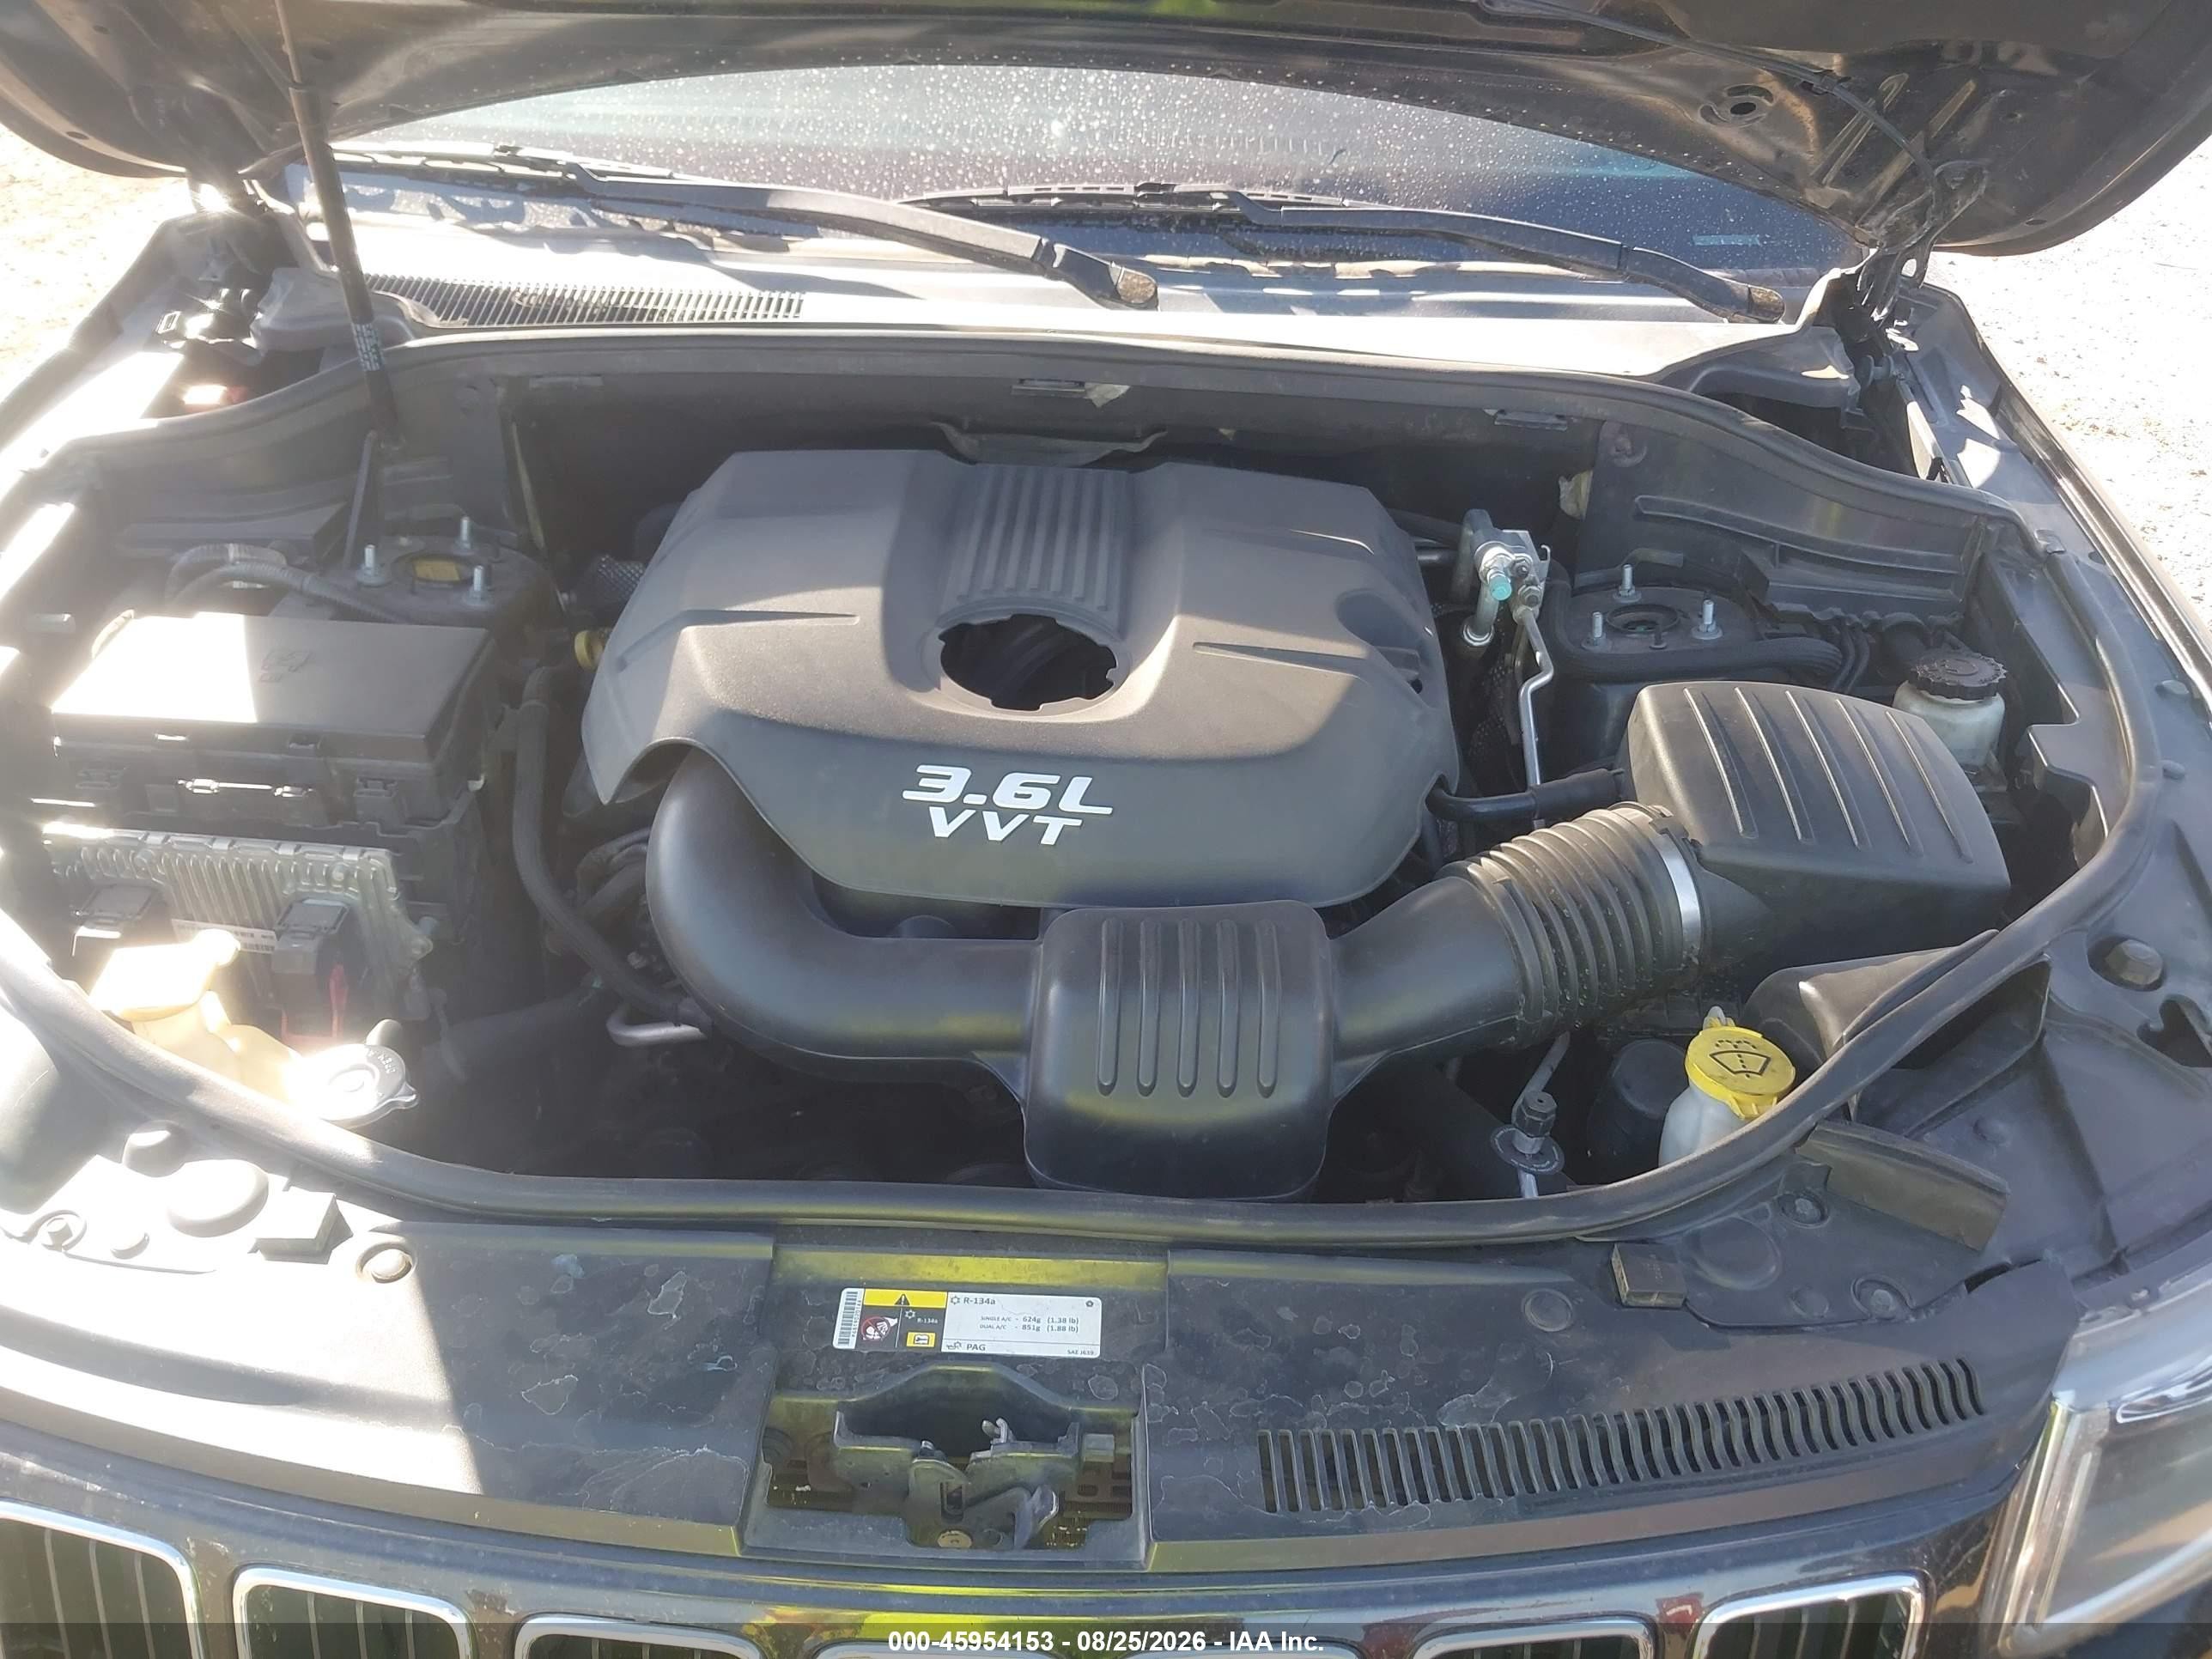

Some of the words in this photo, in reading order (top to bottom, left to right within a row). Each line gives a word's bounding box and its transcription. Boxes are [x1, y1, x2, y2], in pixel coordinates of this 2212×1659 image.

[902, 764, 1114, 815] 3.6L
[928, 805, 1083, 846] VVT
[963, 1297, 996, 1305] R-134a
[966, 1343, 987, 1352] PAG
